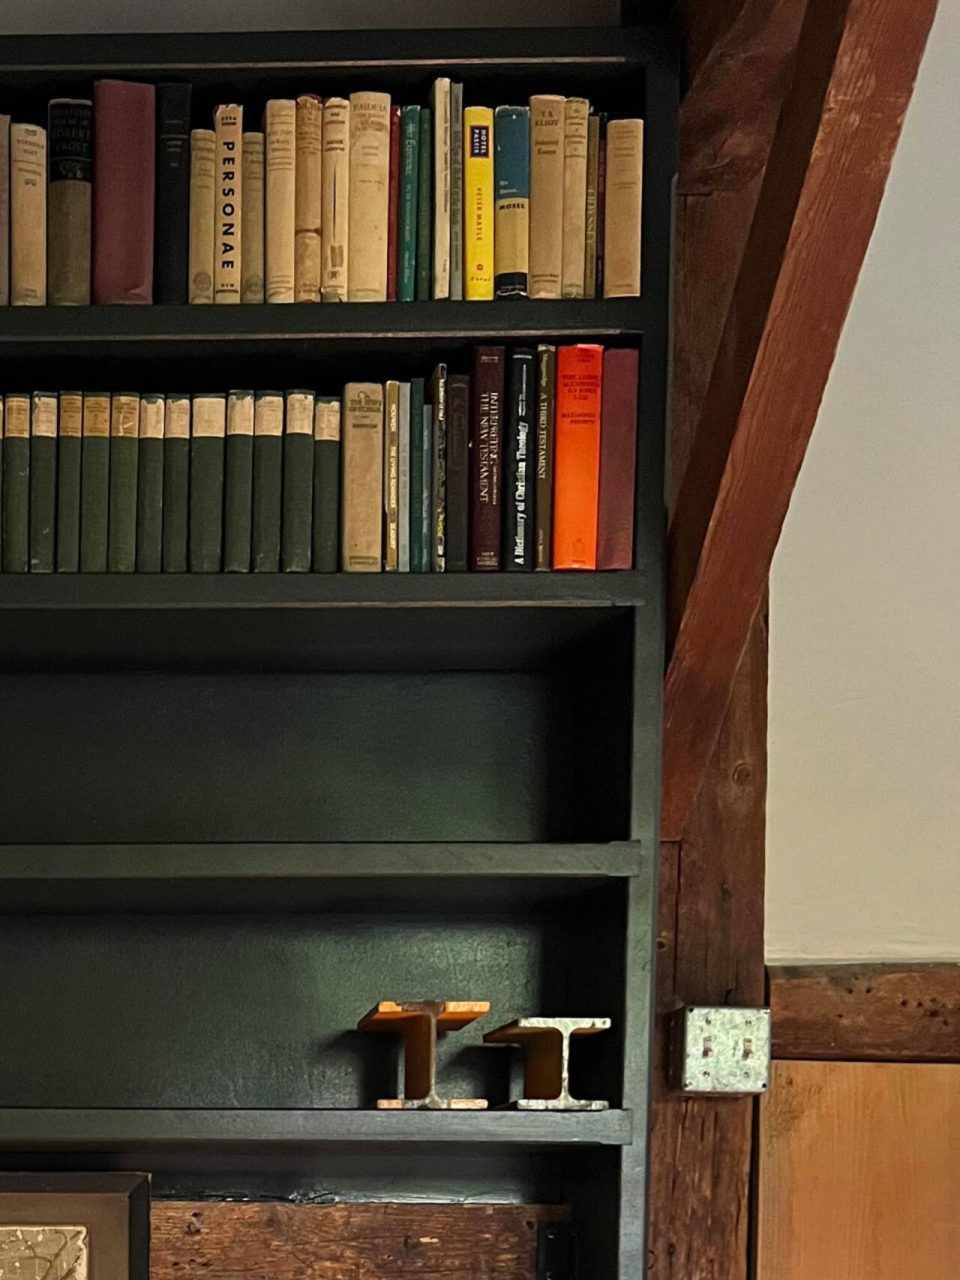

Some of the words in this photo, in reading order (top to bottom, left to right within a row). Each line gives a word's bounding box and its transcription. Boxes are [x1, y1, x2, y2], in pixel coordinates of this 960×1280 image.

[222, 141, 234, 269] PERSONAE
[480, 393, 489, 412] THE
[539, 401, 547, 428] THIRD
[480, 416, 489, 440] NEW
[489, 392, 499, 464] INTERPRETING
[479, 443, 489, 504] TESTAMENT
[538, 430, 547, 480] TESTAMENT
